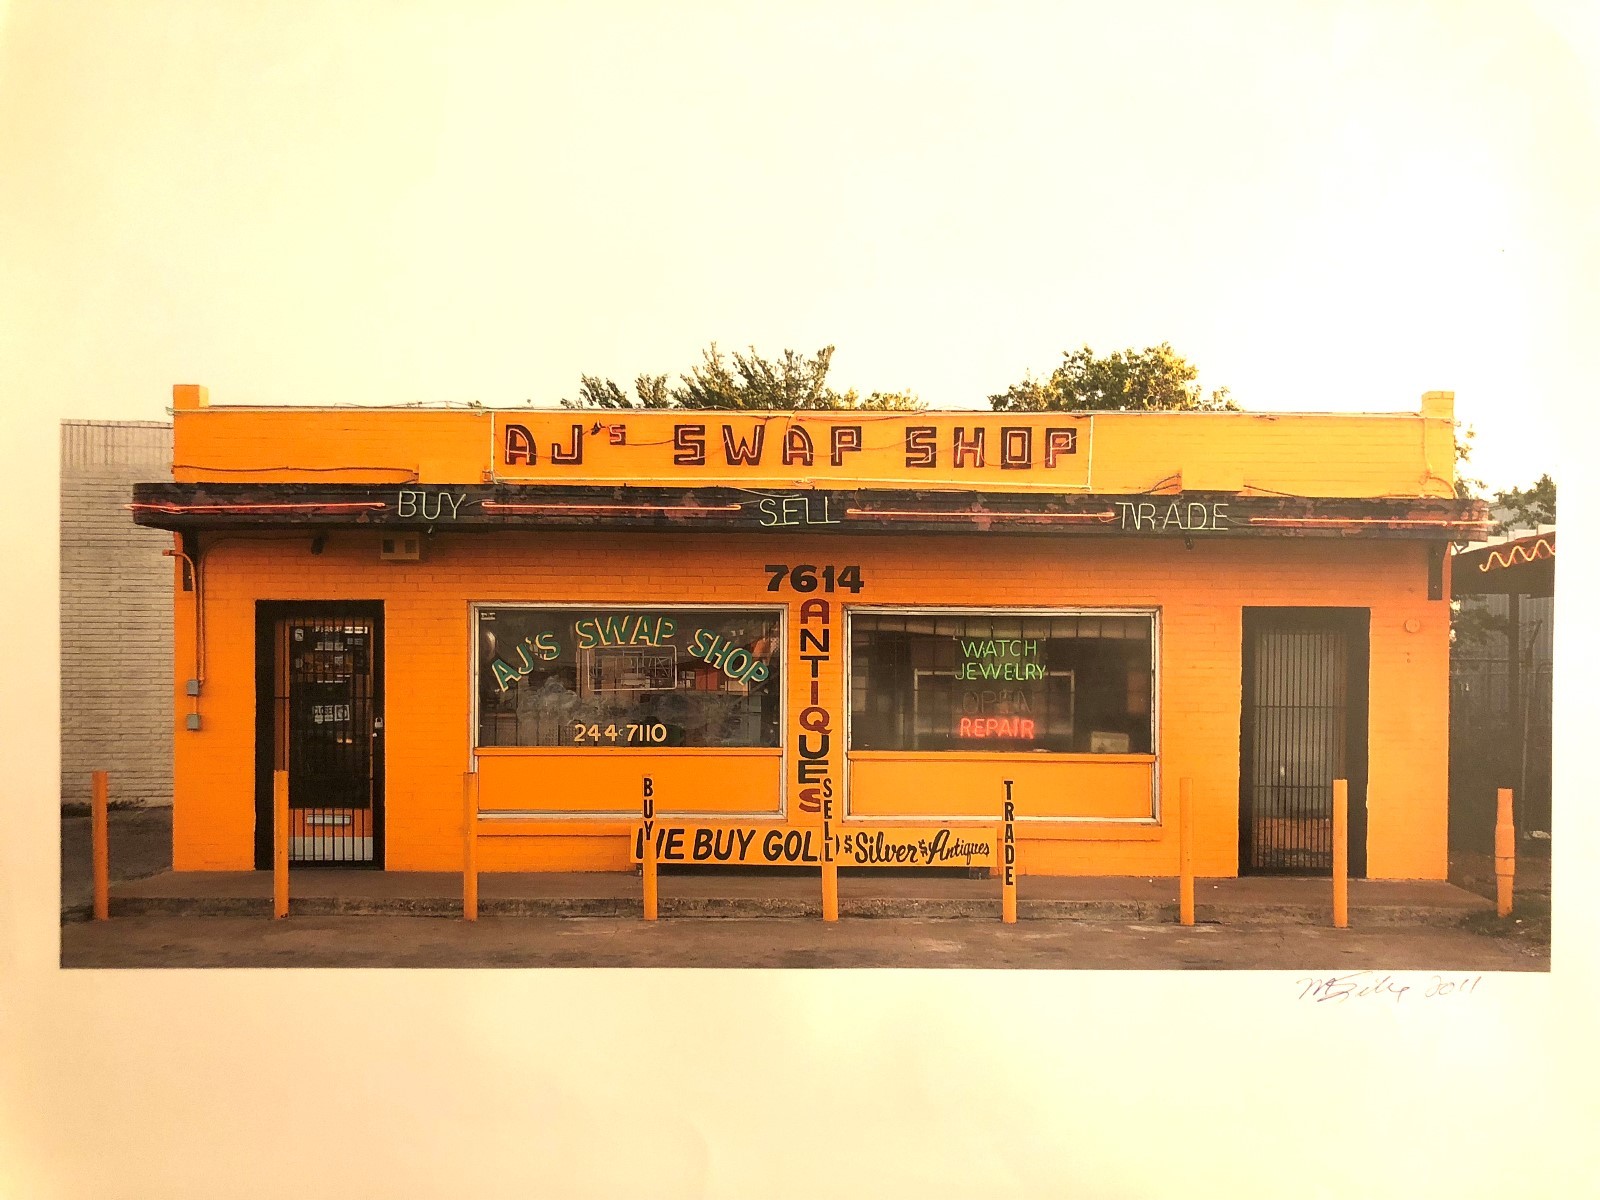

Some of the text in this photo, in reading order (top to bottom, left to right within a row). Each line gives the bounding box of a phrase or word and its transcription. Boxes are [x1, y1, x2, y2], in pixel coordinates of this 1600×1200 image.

[674, 424, 862, 466] SWAP
[905, 426, 1077, 469] SHOP
[398, 490, 1229, 531] BUY SELL TRADE
[764, 564, 865, 593] 7614
[491, 614, 769, 692] AJ'S SWAP SHOP
[961, 639, 1037, 658] WATCH
[955, 662, 1046, 681] JEWELRY
[798, 598, 832, 813] ANTIQUES
[960, 717, 1034, 739] REPAIR
[643, 777, 653, 840] BUY
[823, 778, 833, 862] SELL
[692, 828, 756, 861] BUY
[855, 831, 918, 864] Silver
[925, 829, 990, 865] Antiques
[1003, 780, 1015, 885] TRADE
